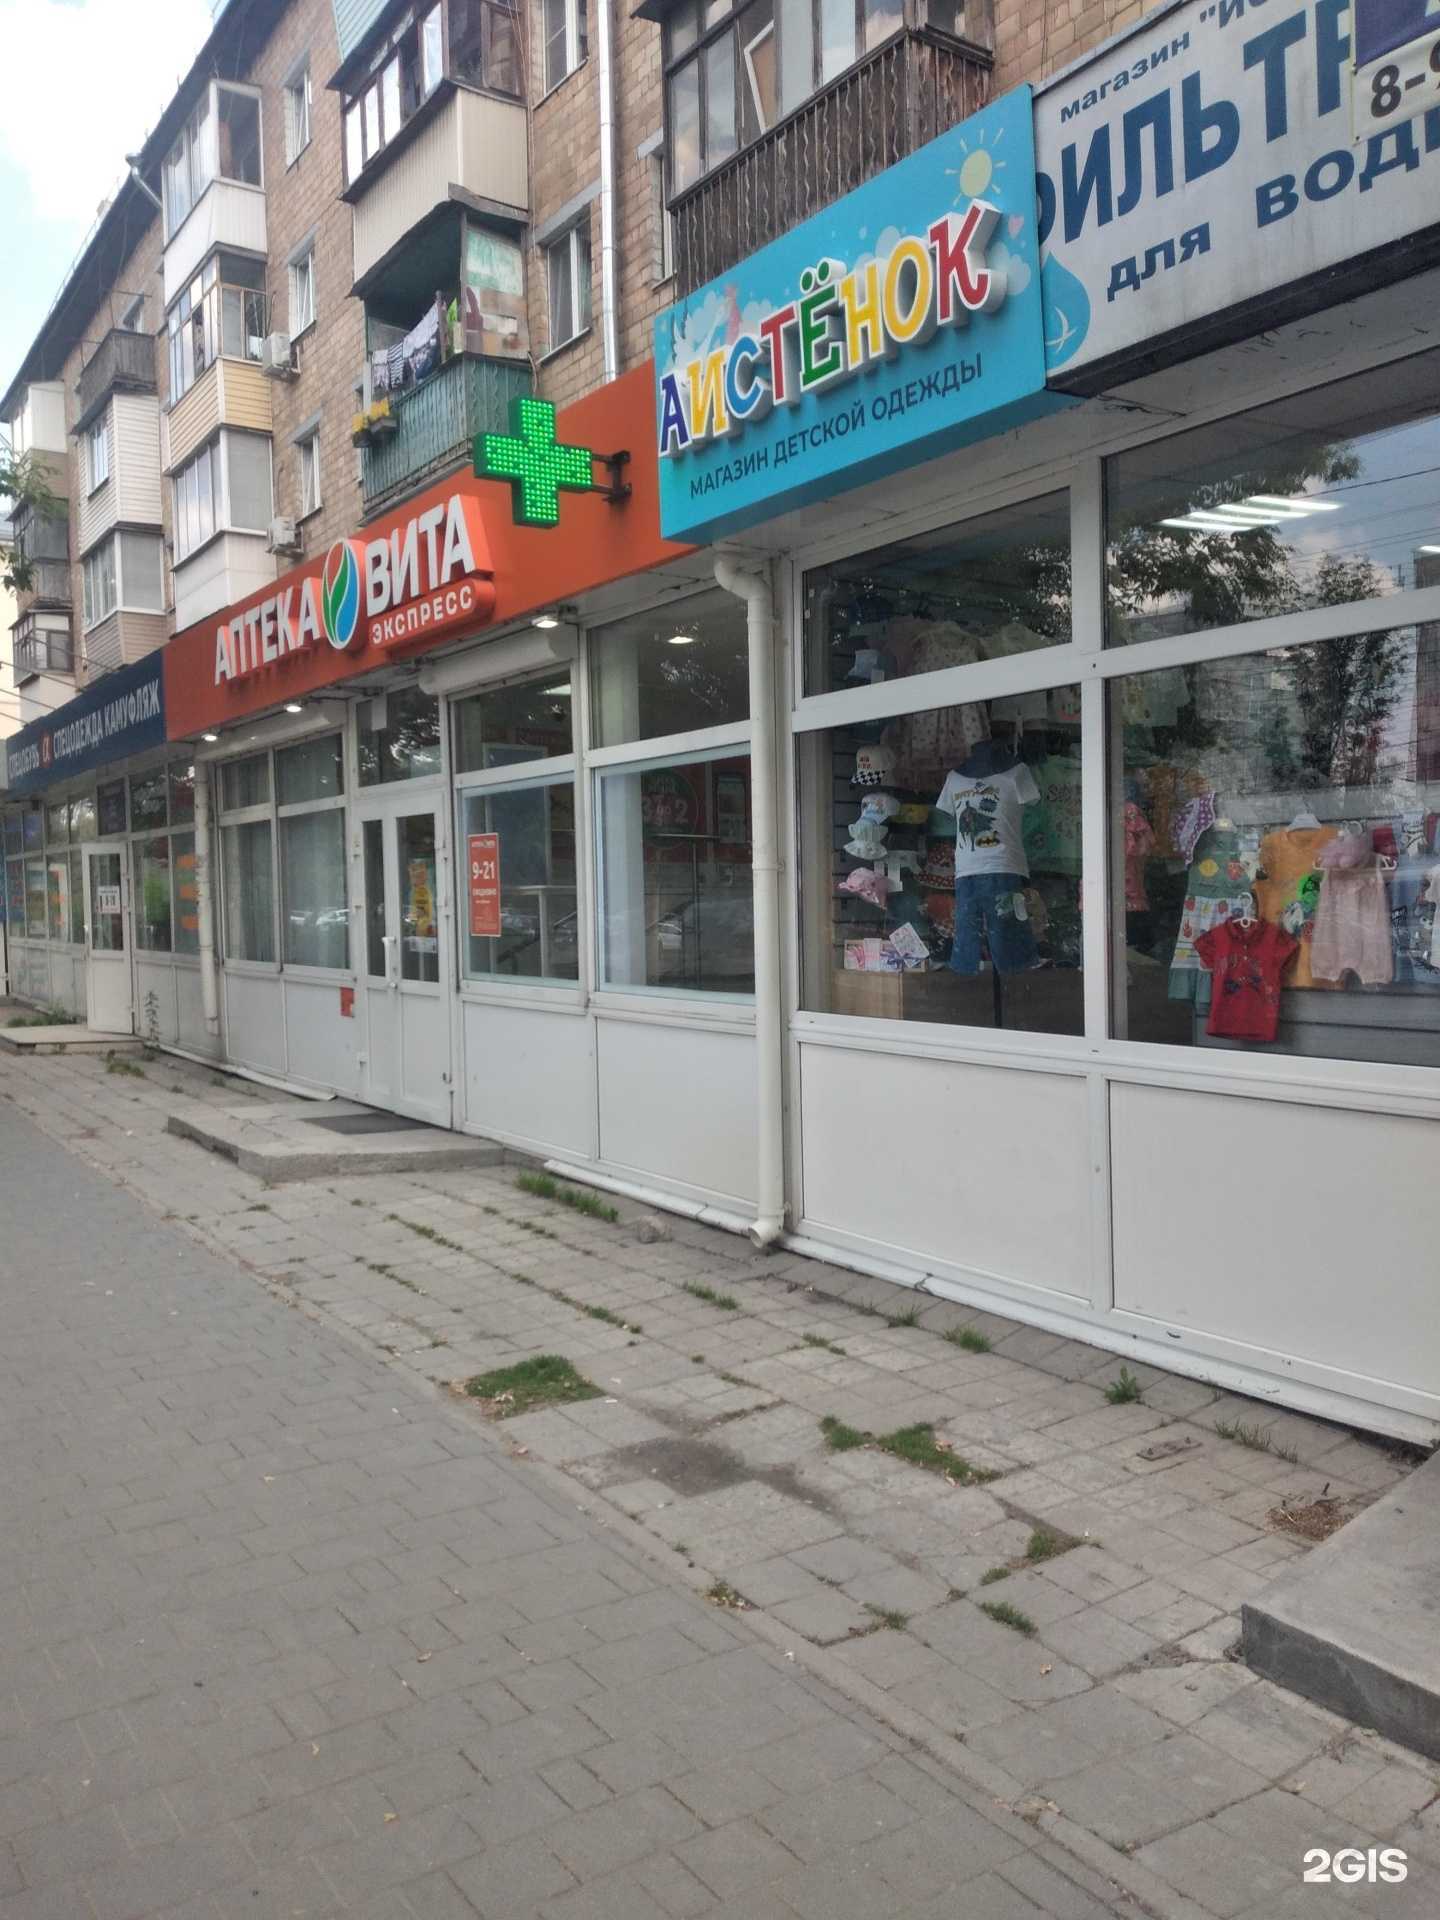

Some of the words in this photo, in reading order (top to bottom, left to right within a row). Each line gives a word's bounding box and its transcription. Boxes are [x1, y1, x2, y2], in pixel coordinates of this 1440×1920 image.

[1060, 31, 1190, 124] магазин
[658, 198, 998, 458] АИСТЁНОК
[690, 445, 769, 499] МАГАЗИН
[774, 394, 866, 466] ДЕТСКОЙ
[871, 352, 983, 420] ОДЕЖДЫ
[214, 577, 321, 686] АПТЕКА
[365, 494, 477, 618] ВИТА
[371, 585, 474, 645] ЭКСПРЕСС
[53, 709, 104, 760] СПЕЦОДЕЖДА
[104, 679, 161, 737] КАМУФЛЯЖ
[472, 861, 495, 880] 9-21
